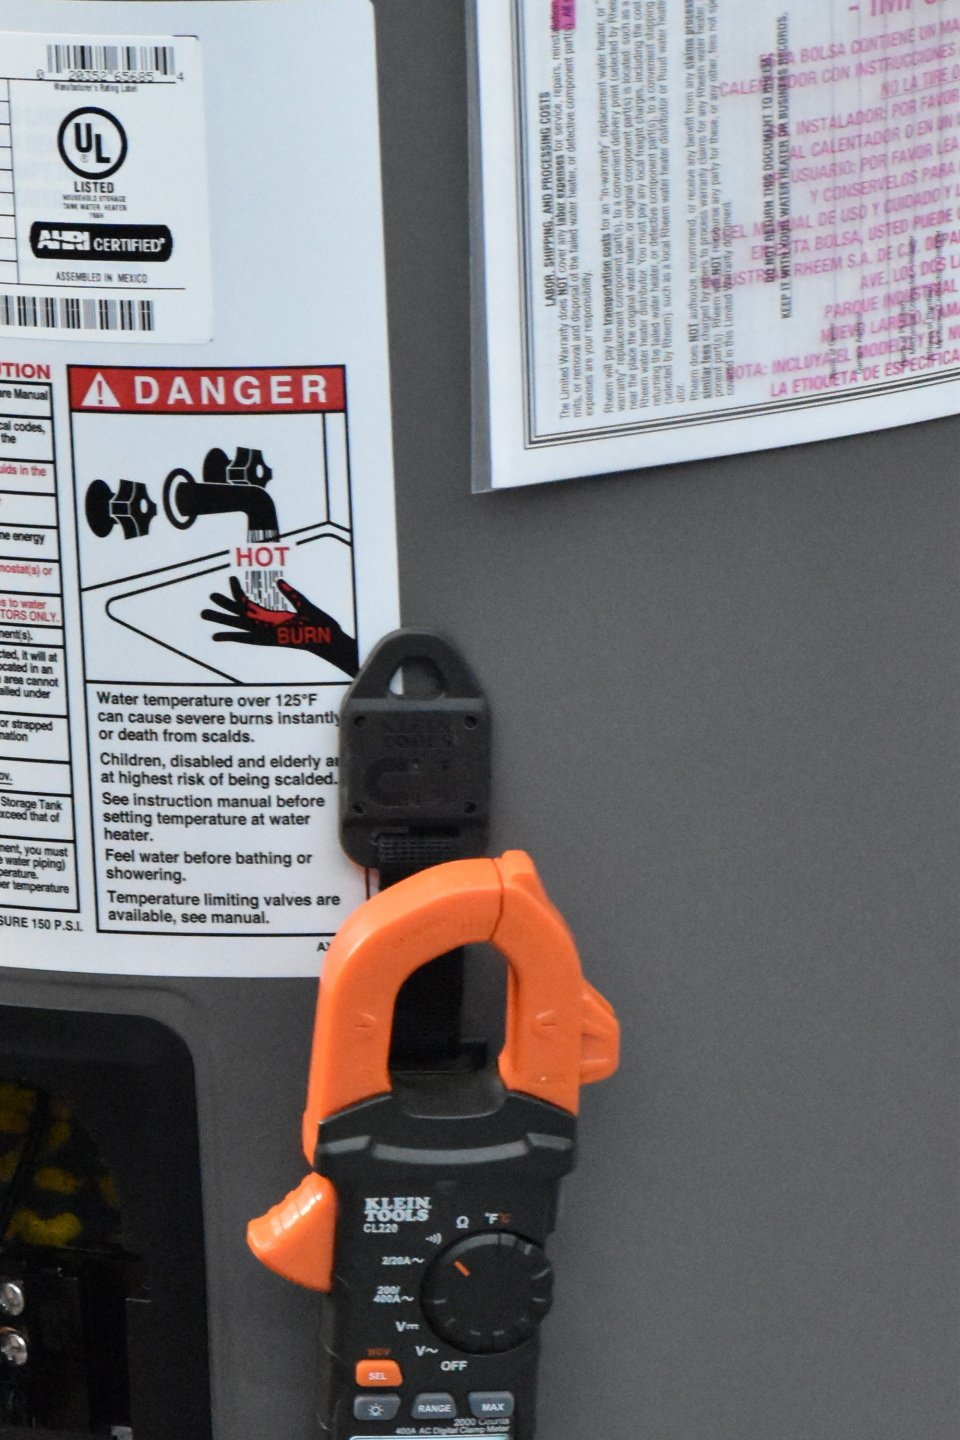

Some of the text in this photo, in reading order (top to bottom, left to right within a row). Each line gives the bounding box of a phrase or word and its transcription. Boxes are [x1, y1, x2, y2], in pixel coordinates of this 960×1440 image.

[800, 28, 915, 63] BOLSA CONTIENE
[69, 70, 107, 81] 20352
[177, 72, 184, 81] 4
[821, 67, 850, 83] CON
[121, 84, 138, 92] Label
[539, 92, 551, 124] COSTS
[796, 100, 917, 136] INSTALADOR: POR
[74, 122, 110, 164] UL
[811, 127, 901, 157] CALENTADOR
[541, 126, 552, 191] PROCESSING
[860, 154, 887, 172] POR
[891, 143, 933, 162] FAVOR
[74, 181, 114, 194] LISTED
[542, 192, 553, 214] AND
[543, 216, 555, 267] SHIPPING,
[56, 272, 148, 284] ASSEMBLED IN MEXICO
[770, 381, 787, 398] LA
[863, 364, 880, 381] DE
[14, 389, 48, 400] Manual
[134, 374, 327, 405] DANGER
[236, 547, 290, 567] HOT
[29, 611, 60, 622] ONLY.
[277, 626, 331, 644] BURN
[97, 691, 318, 708] Water temperature over 125°F
[98, 711, 340, 727] can cause severe burns instantly
[99, 728, 255, 743] or death from scalds.
[100, 752, 166, 769] Children,
[170, 754, 233, 768] disabled
[237, 755, 265, 768] and
[270, 755, 320, 770] elderly
[101, 772, 339, 788] at highest risk of being scalded.
[102, 792, 325, 807] See instruction manual before
[103, 812, 310, 827] setting temperature at water
[104, 828, 154, 842] heater.
[105, 849, 312, 866] Feel water before bathing or
[106, 867, 186, 883] showering.
[107, 890, 341, 909] Temperature limiting valves are
[32, 919, 51, 929] 150
[108, 909, 269, 924] available, see manual.
[364, 1197, 432, 1209] KLEIN
[364, 1209, 429, 1222] TOOLS
[363, 1224, 398, 1233] CL220
[441, 1360, 468, 1371] OFF
[368, 1372, 387, 1380] SEL
[482, 1403, 504, 1412] MAX
[433, 1427, 458, 1435] Digital
[460, 1426, 485, 1435] Clamp
[487, 1425, 510, 1433] Meter
